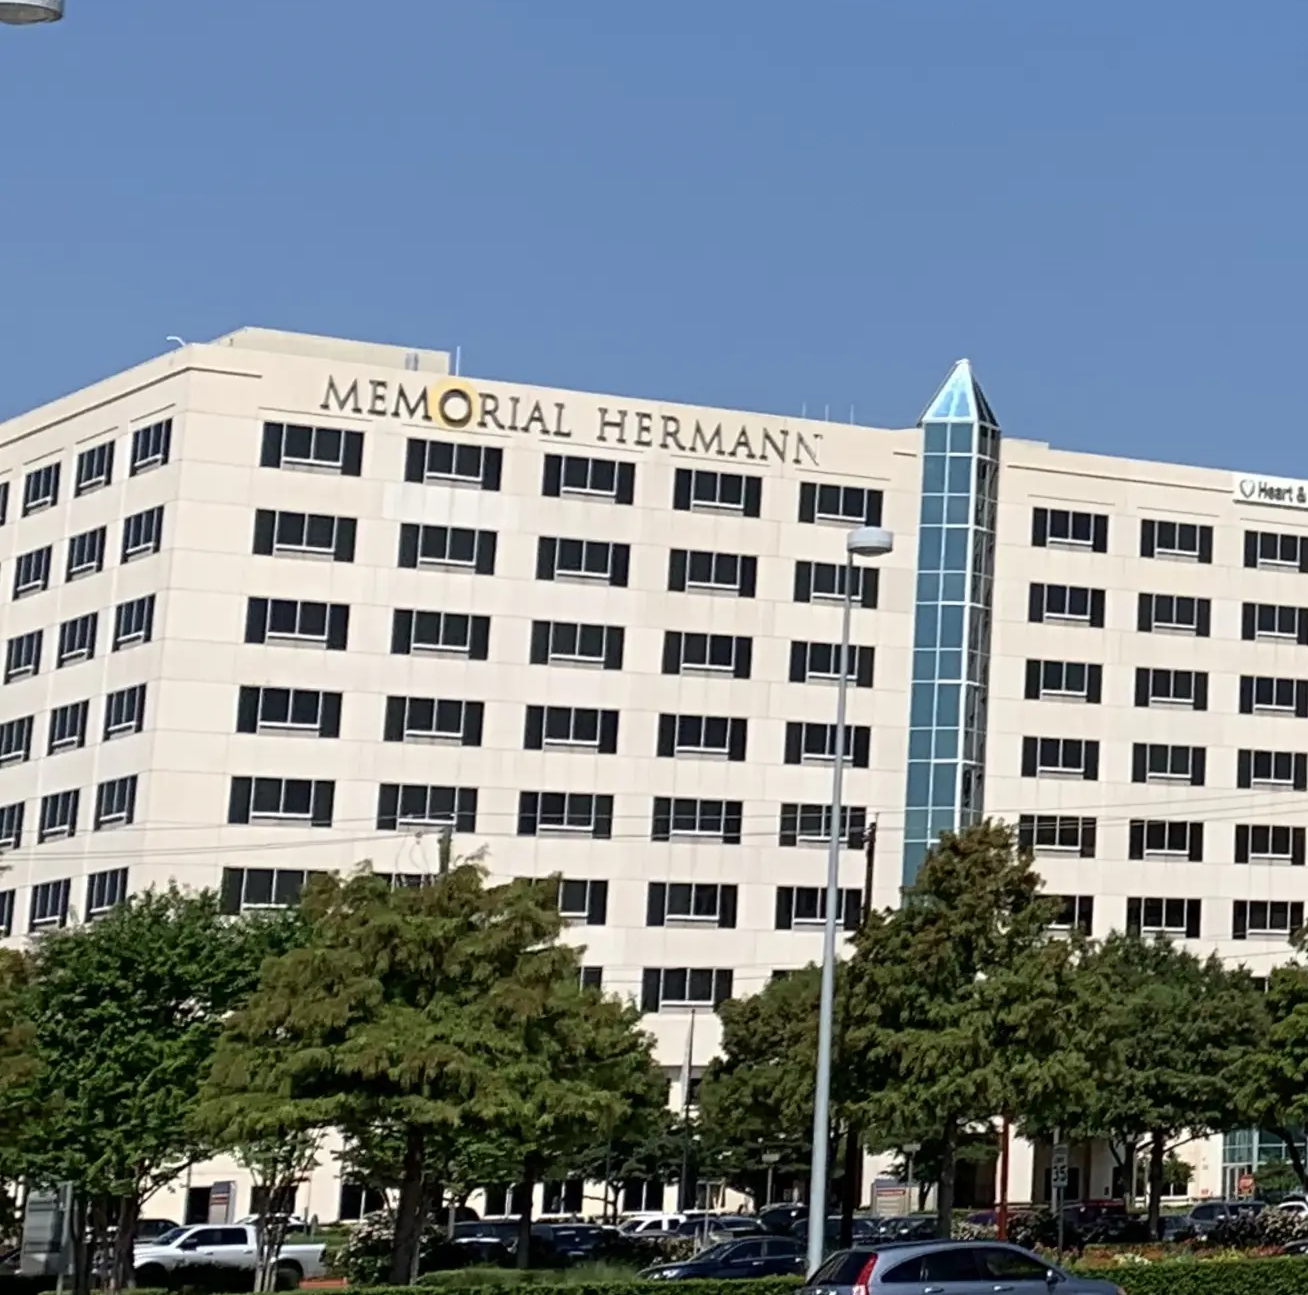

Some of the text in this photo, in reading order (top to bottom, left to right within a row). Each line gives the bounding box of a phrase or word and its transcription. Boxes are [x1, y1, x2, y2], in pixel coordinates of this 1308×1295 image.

[320, 374, 824, 466] MEMORIAL HERMANN
[1257, 481, 1294, 502] Heart
[1297, 486, 1308, 504] &
